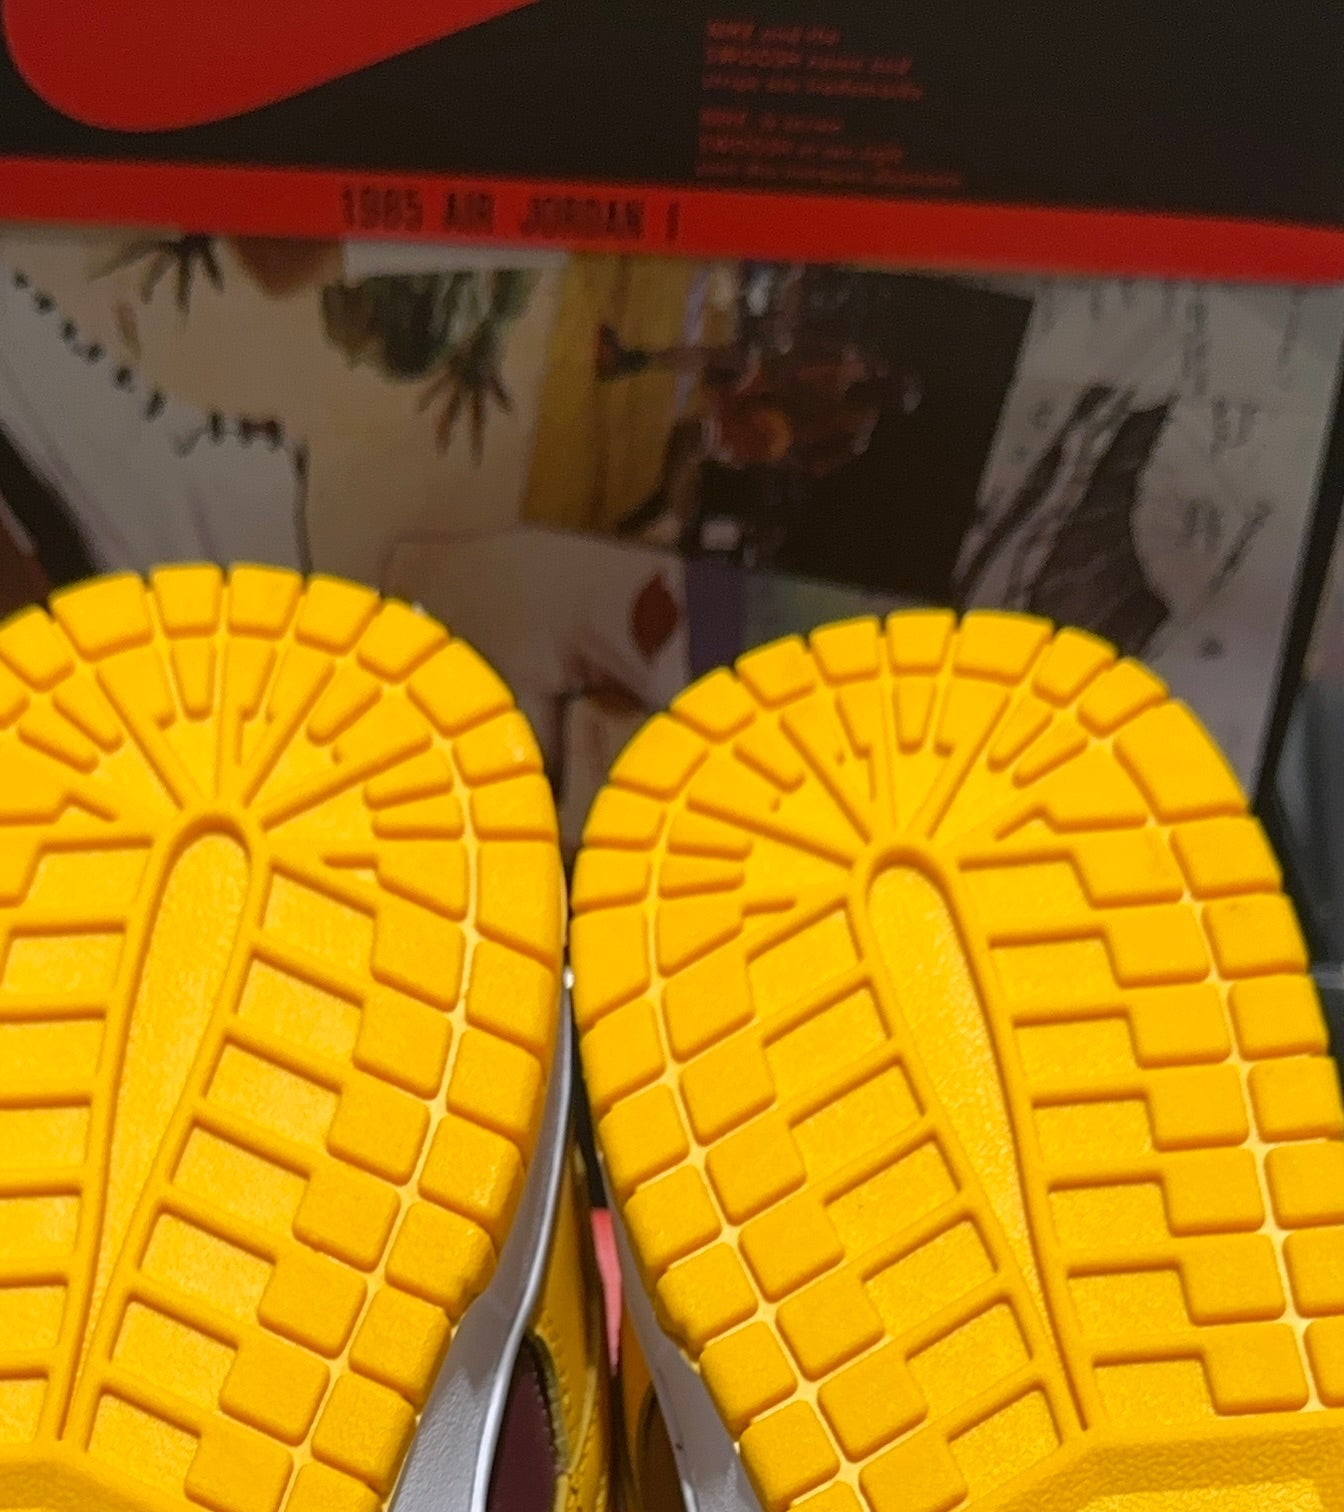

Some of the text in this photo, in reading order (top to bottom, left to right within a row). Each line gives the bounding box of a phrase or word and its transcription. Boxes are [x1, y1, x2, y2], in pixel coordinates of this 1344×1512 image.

[342, 185, 424, 231] 1985
[443, 190, 495, 233] AIR
[521, 196, 645, 240] JORDAN
